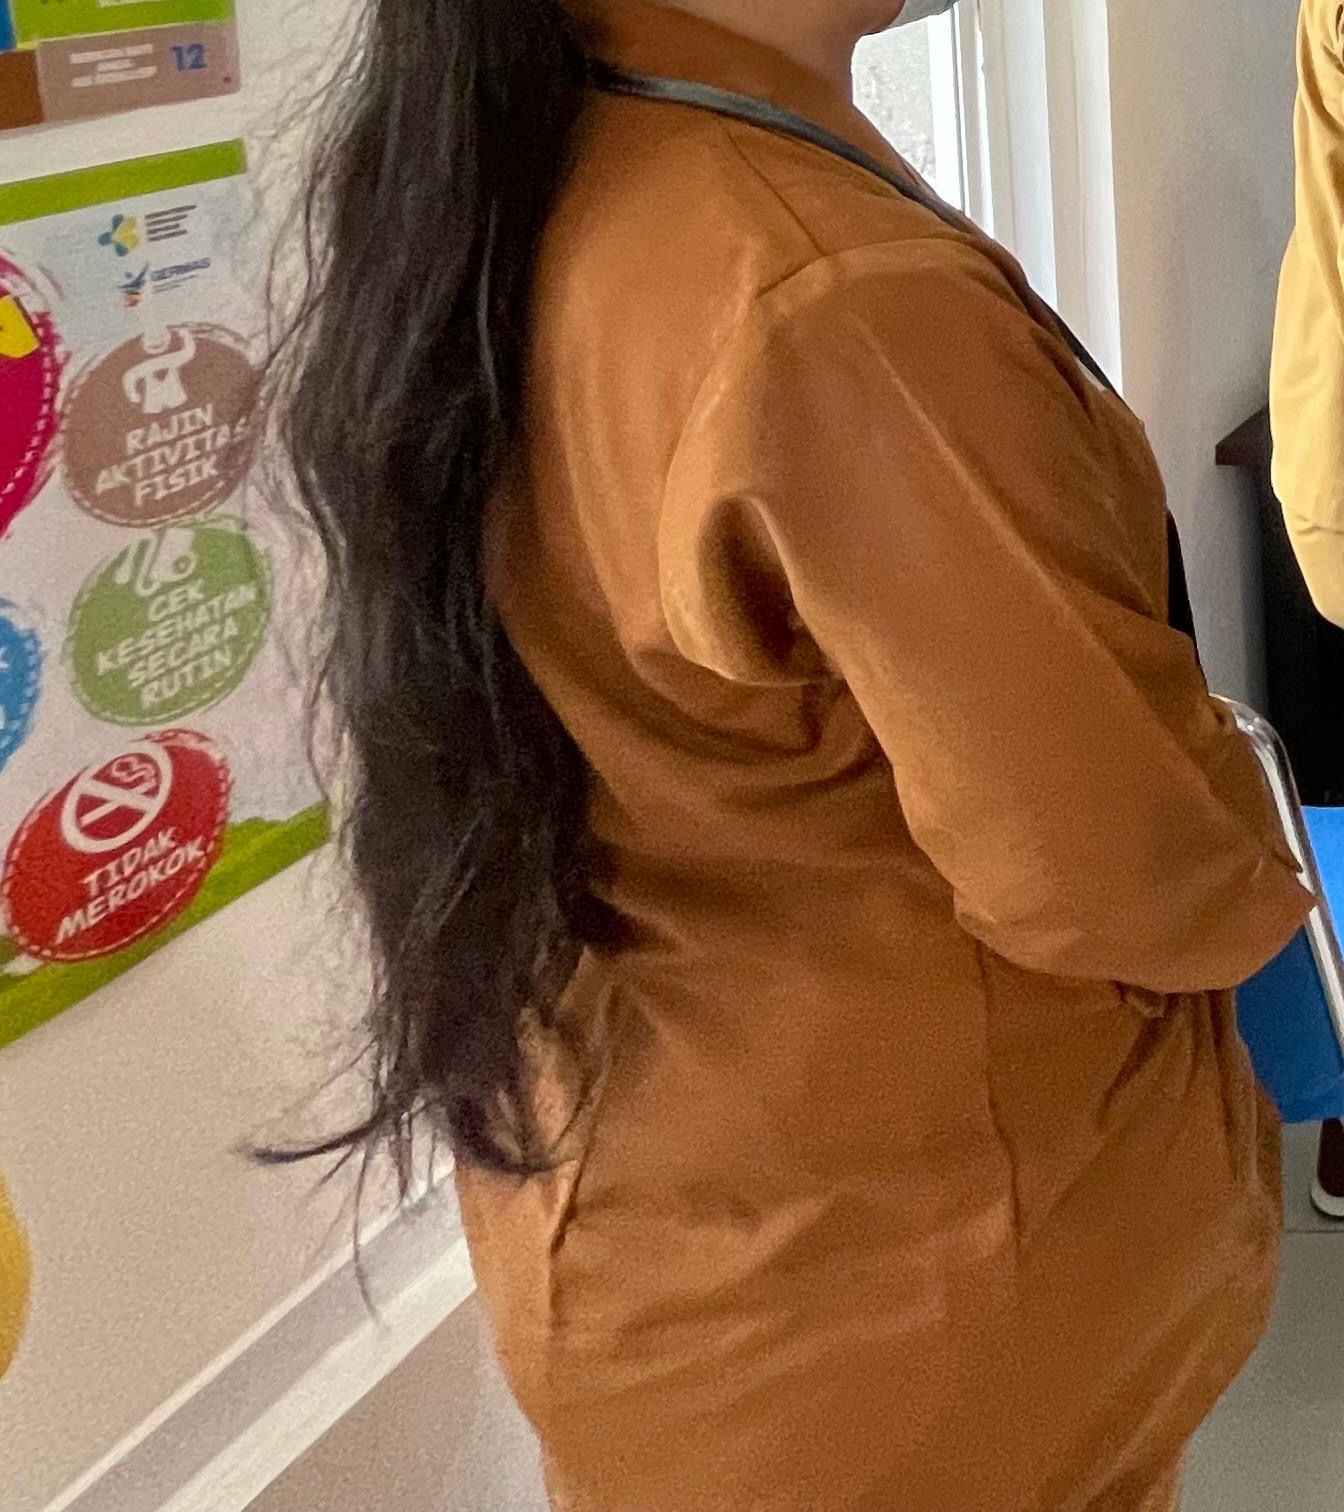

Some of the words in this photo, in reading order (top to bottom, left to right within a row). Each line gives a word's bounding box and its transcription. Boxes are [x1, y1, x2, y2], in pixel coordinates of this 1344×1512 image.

[169, 43, 208, 71] 12
[95, 415, 248, 496] AKTIVITAS
[126, 403, 213, 456] RAJIN
[134, 454, 219, 507] FISIK
[96, 583, 257, 676] KESEHATAN
[148, 579, 206, 622] CEK
[128, 617, 239, 688] SECARA
[141, 645, 232, 709] RUTIN
[54, 836, 206, 945] MEROKOK
[81, 826, 177, 897] TIDAK
